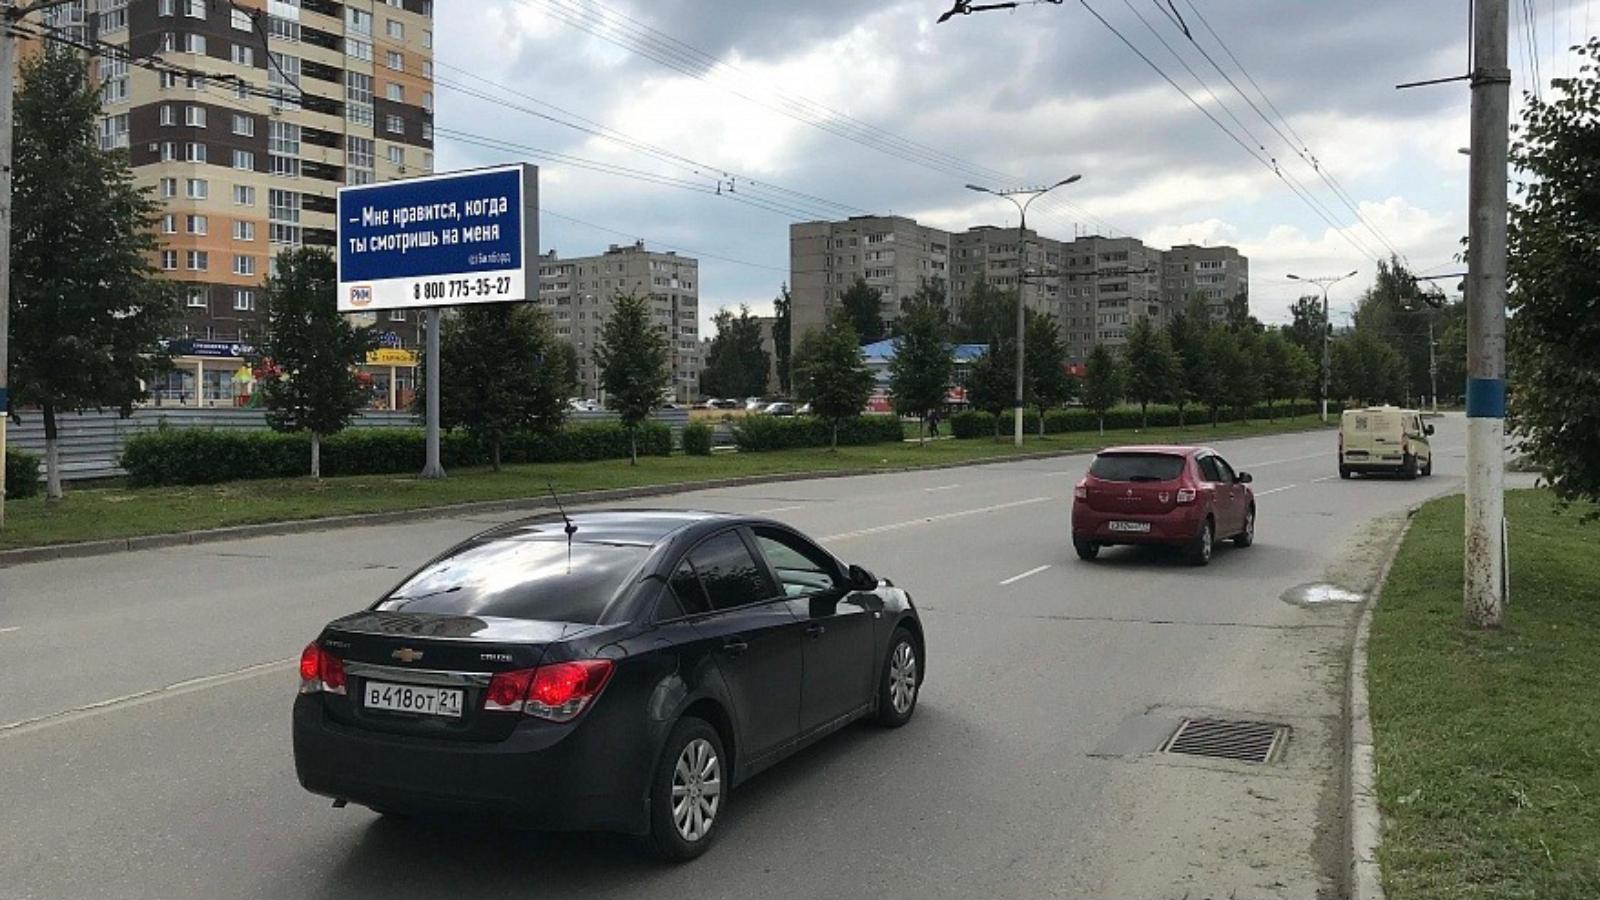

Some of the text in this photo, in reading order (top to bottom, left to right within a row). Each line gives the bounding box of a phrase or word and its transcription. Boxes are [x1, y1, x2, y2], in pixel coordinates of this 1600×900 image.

[362, 206, 389, 227] Мне
[393, 202, 461, 229] нравится,
[465, 196, 507, 217] когда
[349, 223, 500, 254] ты смотришь на меня
[413, 276, 511, 300] 8 800 775-35-27
[440, 691, 457, 707] 21
